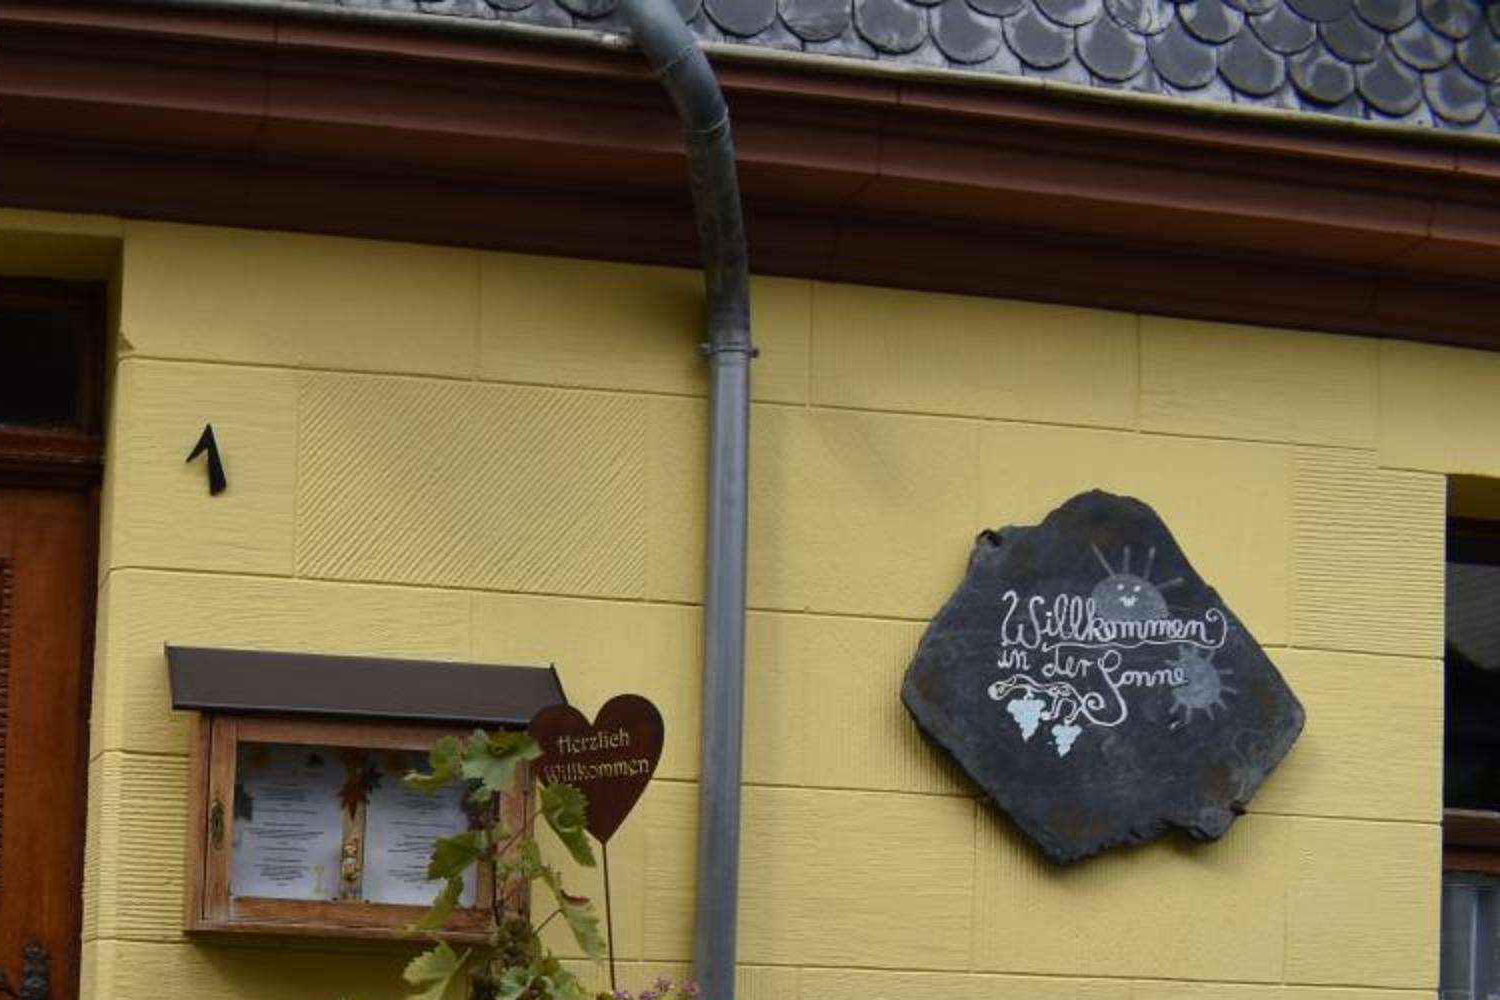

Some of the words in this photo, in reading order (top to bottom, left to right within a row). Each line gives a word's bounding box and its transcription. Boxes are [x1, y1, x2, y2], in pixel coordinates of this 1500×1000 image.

[185, 422, 227, 497] 1
[1001, 590, 1228, 649] Willkommen
[998, 643, 1030, 671] in
[1041, 646, 1094, 678] der
[1080, 649, 1189, 727] Sonne
[557, 726, 631, 753] Herzlich
[542, 757, 650, 784] Willkommen
